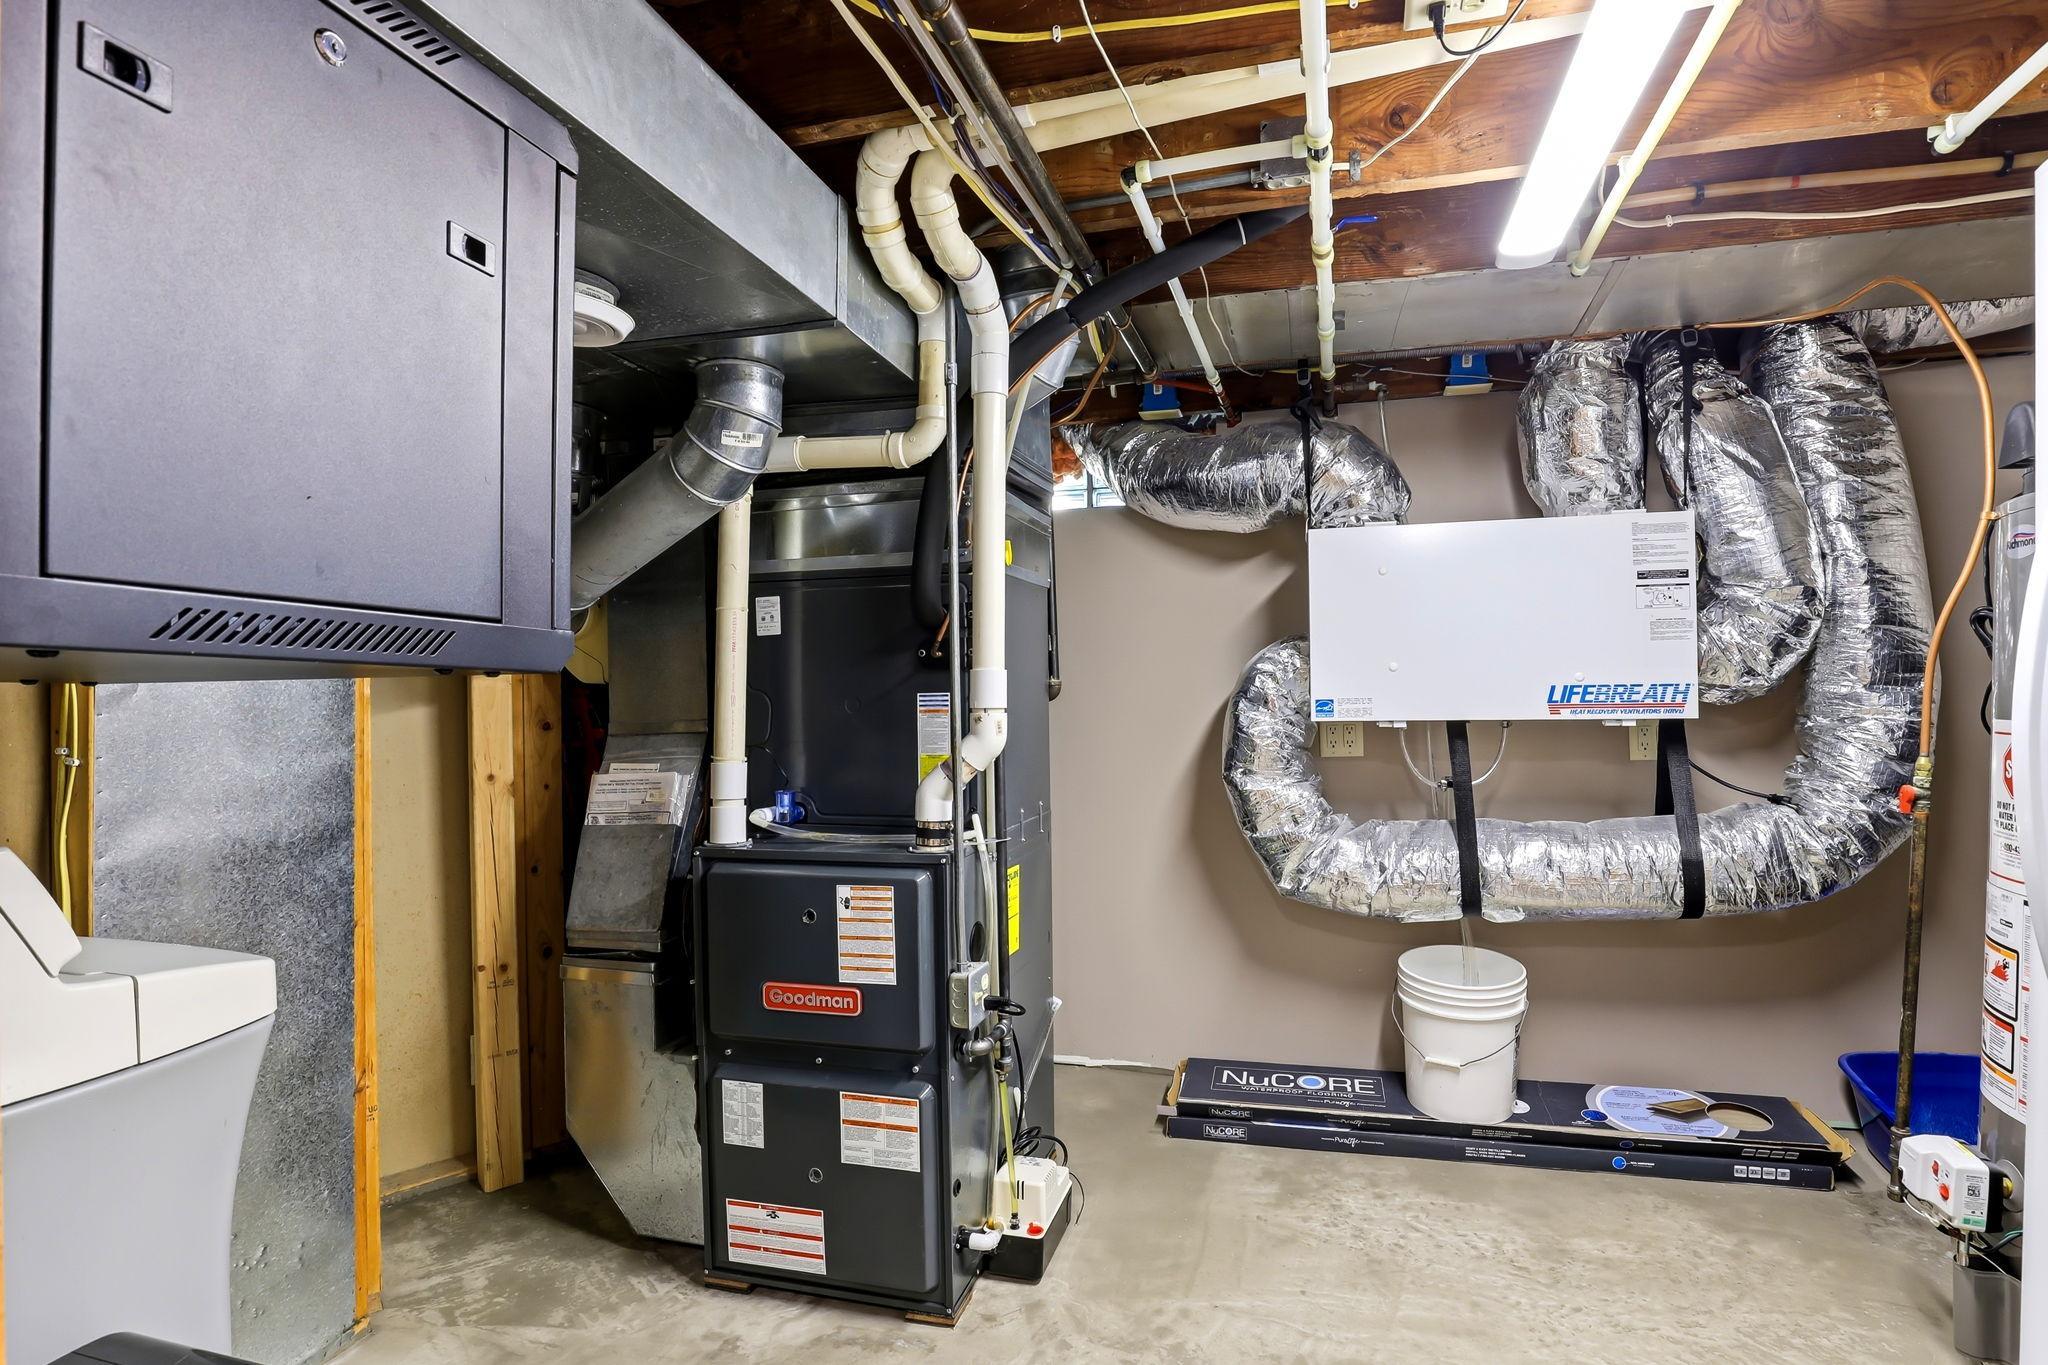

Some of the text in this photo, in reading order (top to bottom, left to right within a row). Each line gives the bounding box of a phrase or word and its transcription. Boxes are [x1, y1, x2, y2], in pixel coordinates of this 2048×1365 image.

[2006, 536, 2036, 551] Richmon
[1547, 683, 1691, 704] LIFEBREATH
[769, 988, 854, 1009] Goodman
[1222, 1069, 1377, 1094] NuCORE
[1241, 1085, 1354, 1099] WATERPROOF FLOORING
[1211, 1108, 1252, 1118] NuCORE
[1205, 1125, 1246, 1138] NuCORE
